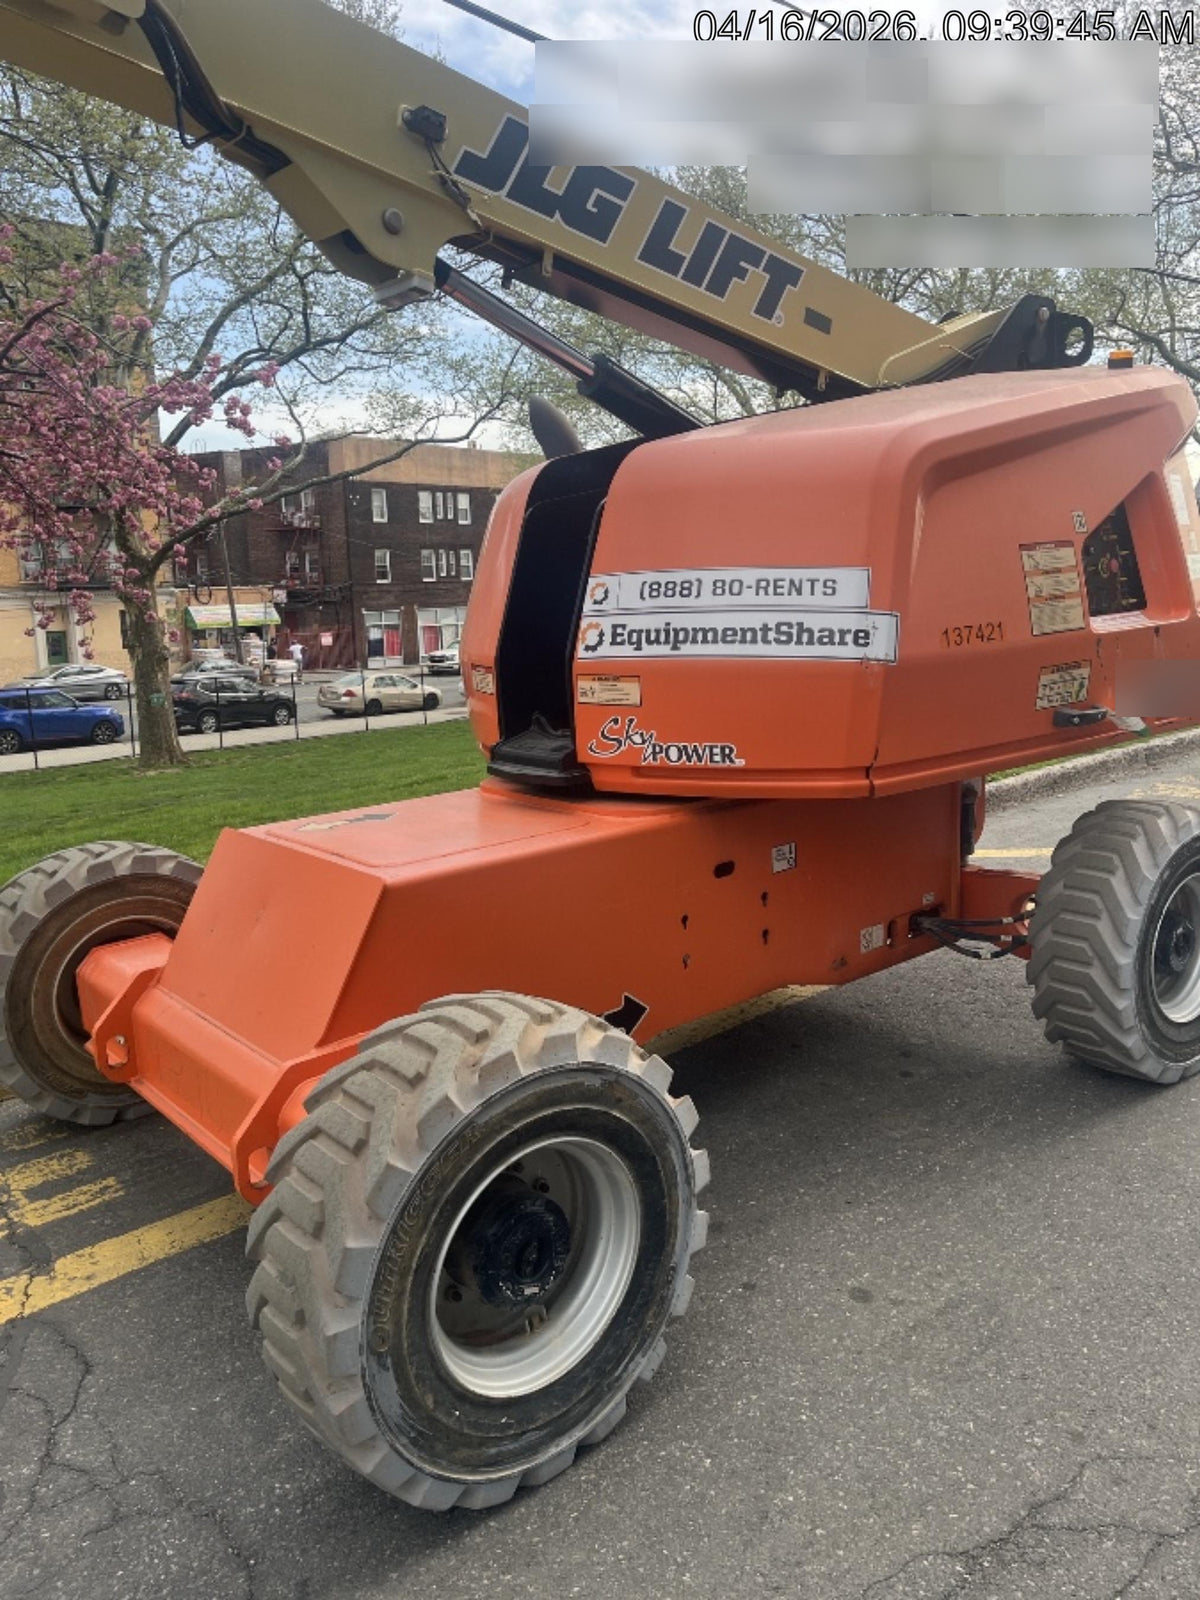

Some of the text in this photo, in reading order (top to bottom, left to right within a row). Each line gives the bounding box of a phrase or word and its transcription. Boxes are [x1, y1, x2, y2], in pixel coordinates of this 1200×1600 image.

[451, 113, 806, 323] JLG LIFT
[639, 578, 837, 601] (888) 80-RENTS
[609, 621, 871, 650] EquipmentShare
[941, 621, 1004, 648] 137421
[587, 716, 655, 765] Sky
[650, 743, 737, 765] POWER
